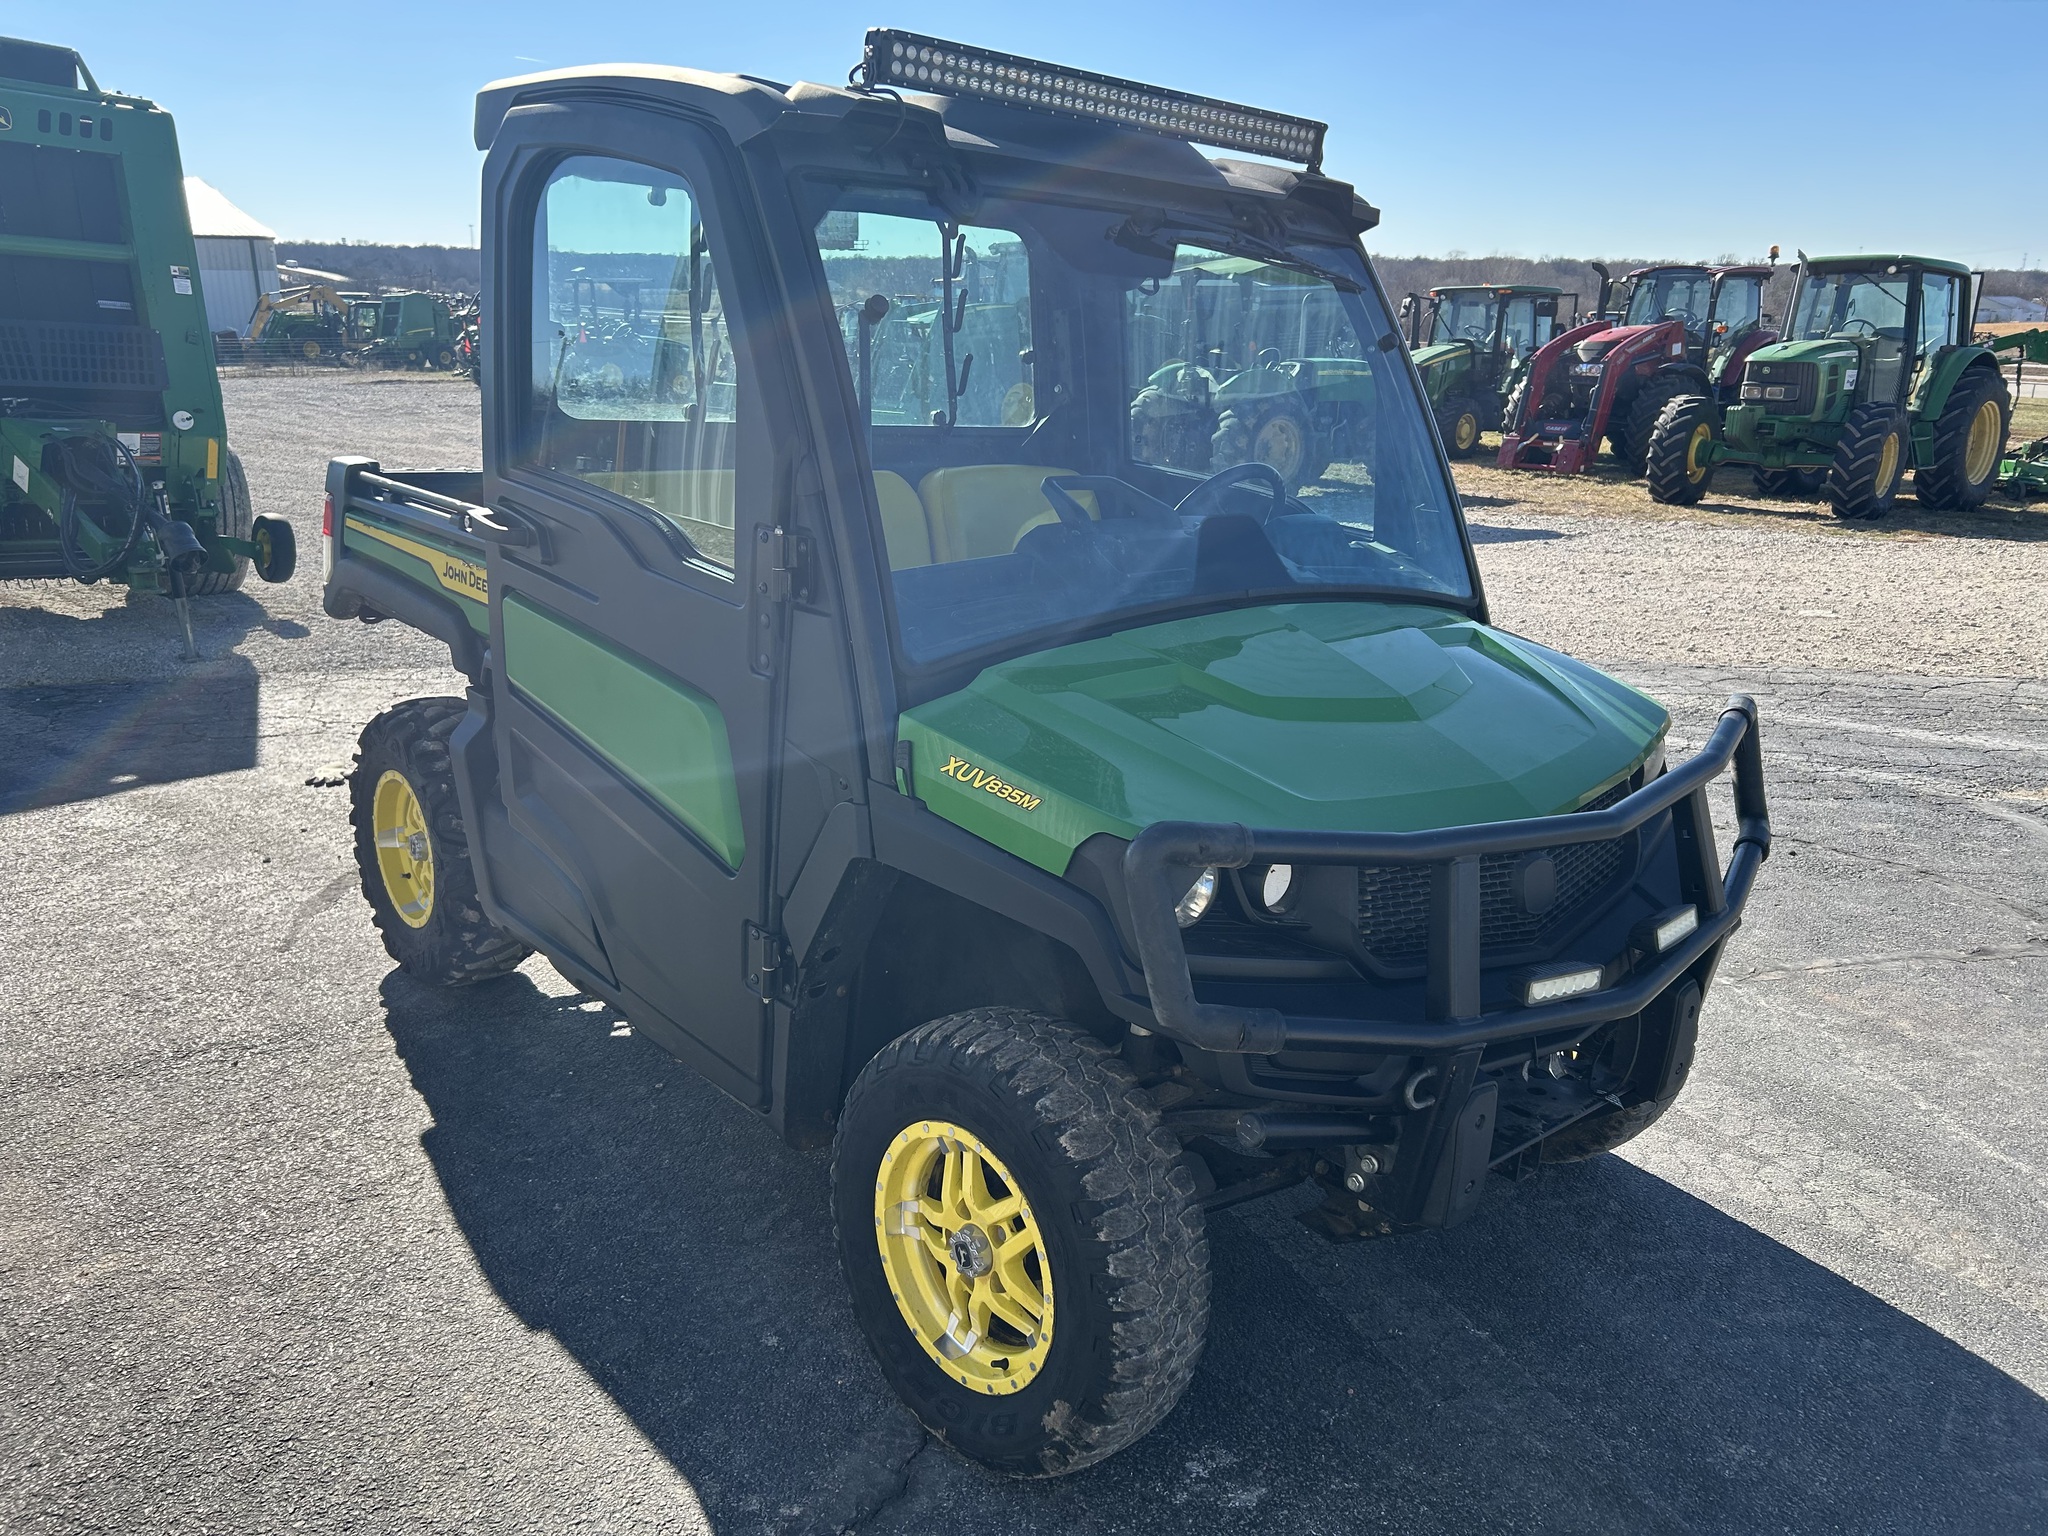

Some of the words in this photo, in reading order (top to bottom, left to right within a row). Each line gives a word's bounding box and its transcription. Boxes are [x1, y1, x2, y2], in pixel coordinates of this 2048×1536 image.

[443, 562, 467, 585] JOHN
[469, 570, 488, 593] DEE
[940, 755, 1043, 811] XUV835M
